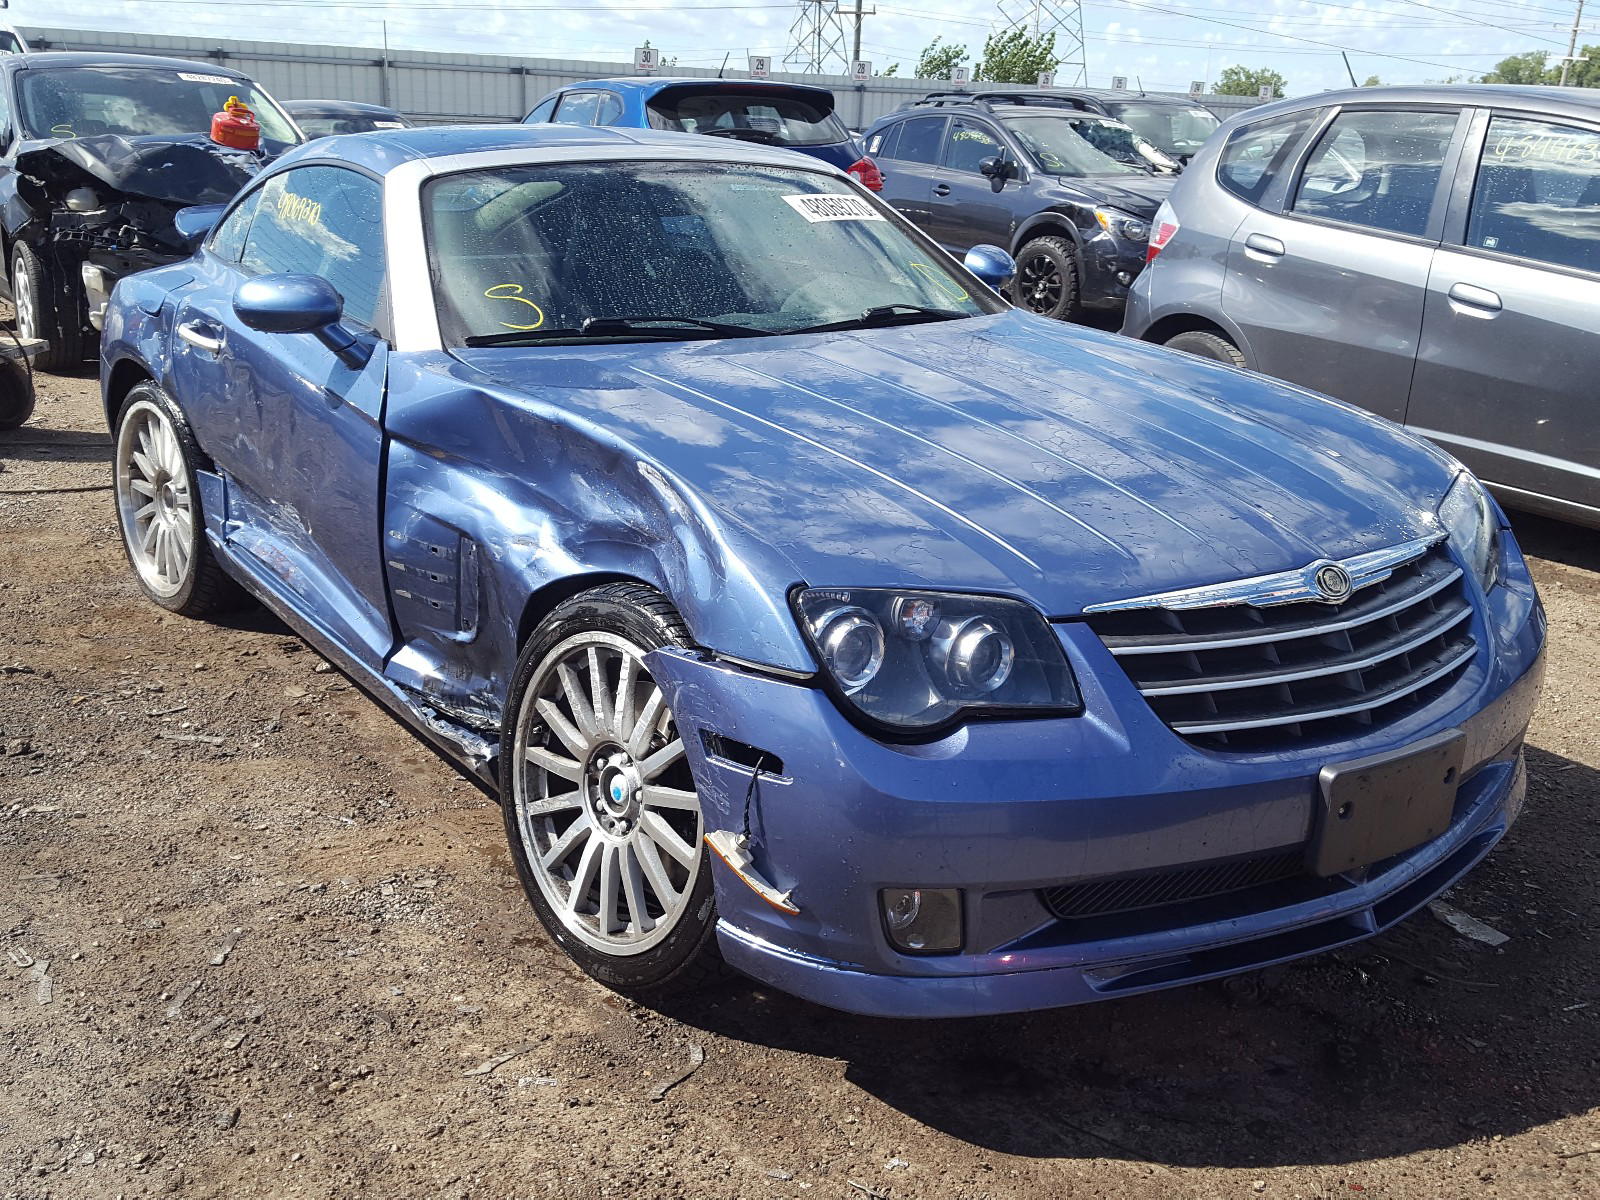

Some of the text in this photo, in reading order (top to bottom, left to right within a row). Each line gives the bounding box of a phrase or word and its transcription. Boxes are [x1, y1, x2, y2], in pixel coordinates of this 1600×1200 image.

[642, 50, 651, 63] 30
[756, 58, 765, 70] 29
[857, 63, 866, 74] 28
[956, 68, 964, 79] 27
